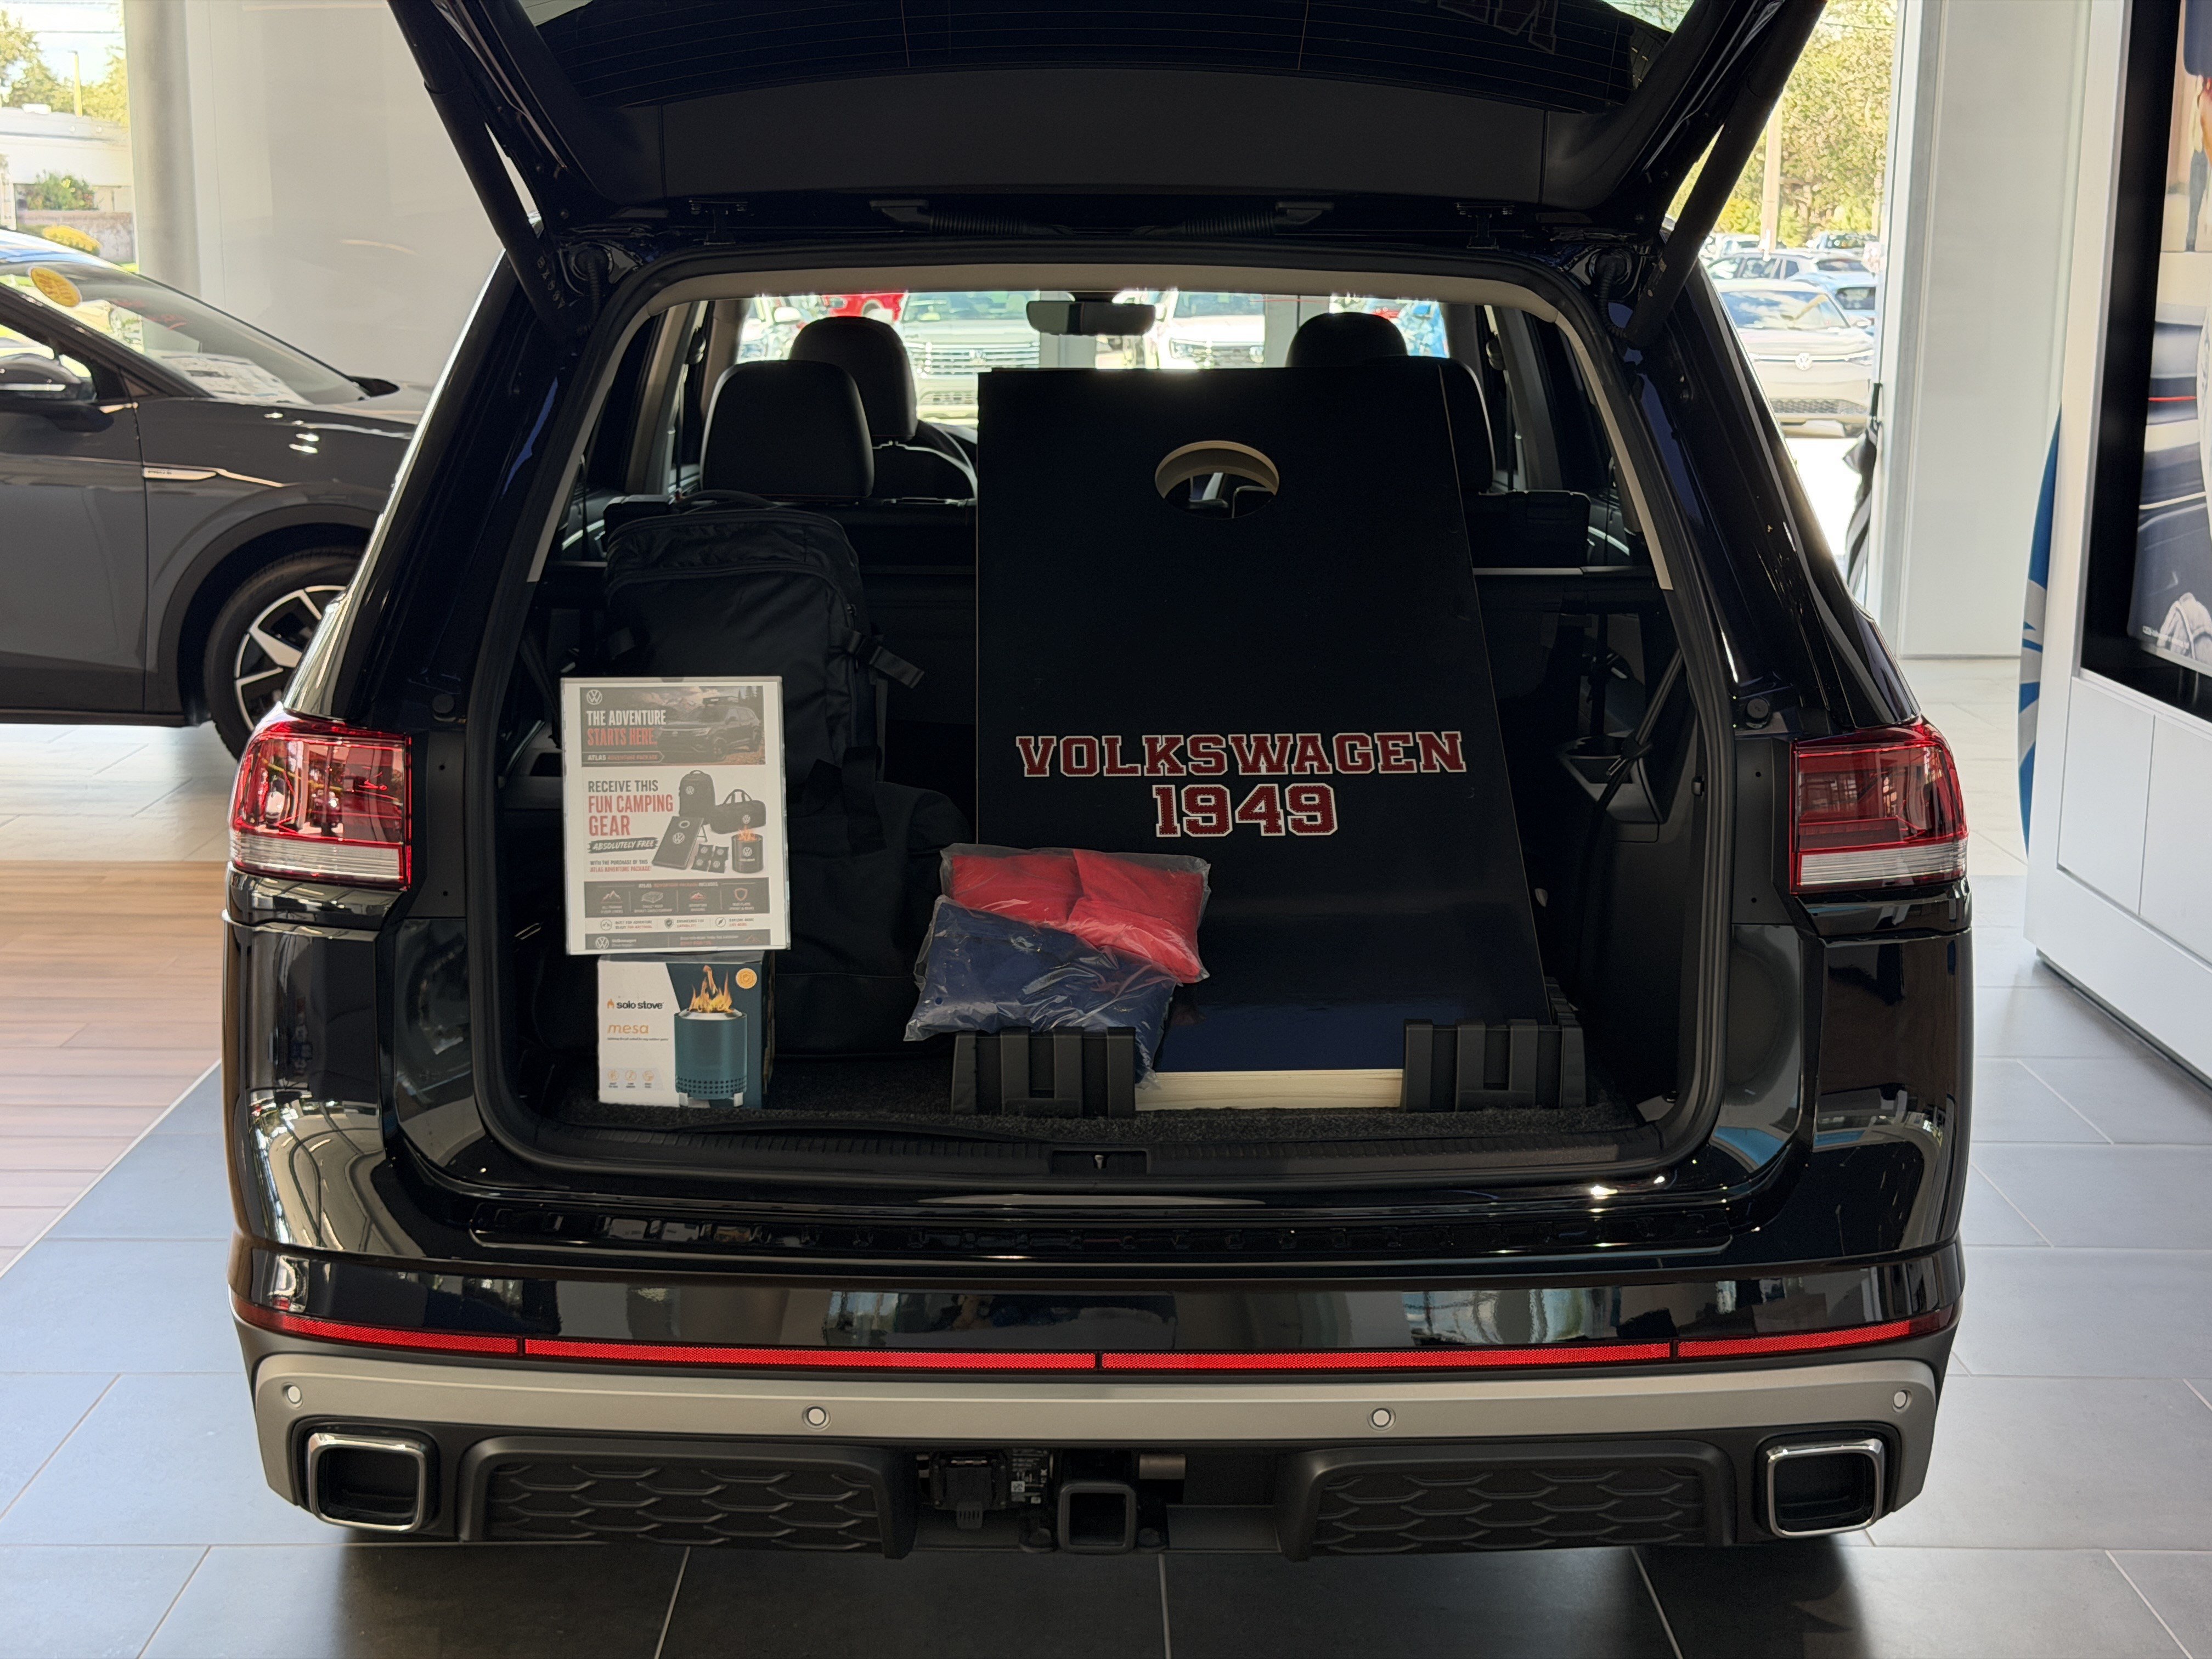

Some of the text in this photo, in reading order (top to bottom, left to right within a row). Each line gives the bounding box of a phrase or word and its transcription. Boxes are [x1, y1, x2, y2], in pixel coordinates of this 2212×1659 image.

[586, 710, 667, 726] THE ADVENTURE
[588, 728, 658, 746] STARTS HERE.
[1016, 731, 1467, 777] VOLKSWAGEN
[588, 780, 658, 793] RECEIVE THIS
[589, 794, 673, 813] FUN CAMPING
[1152, 783, 1338, 837] 1949
[589, 815, 630, 836] GEAR
[592, 840, 636, 850] ABSOLUTELY
[616, 1000, 663, 1009] solo stove
[607, 1024, 649, 1034] mesa
